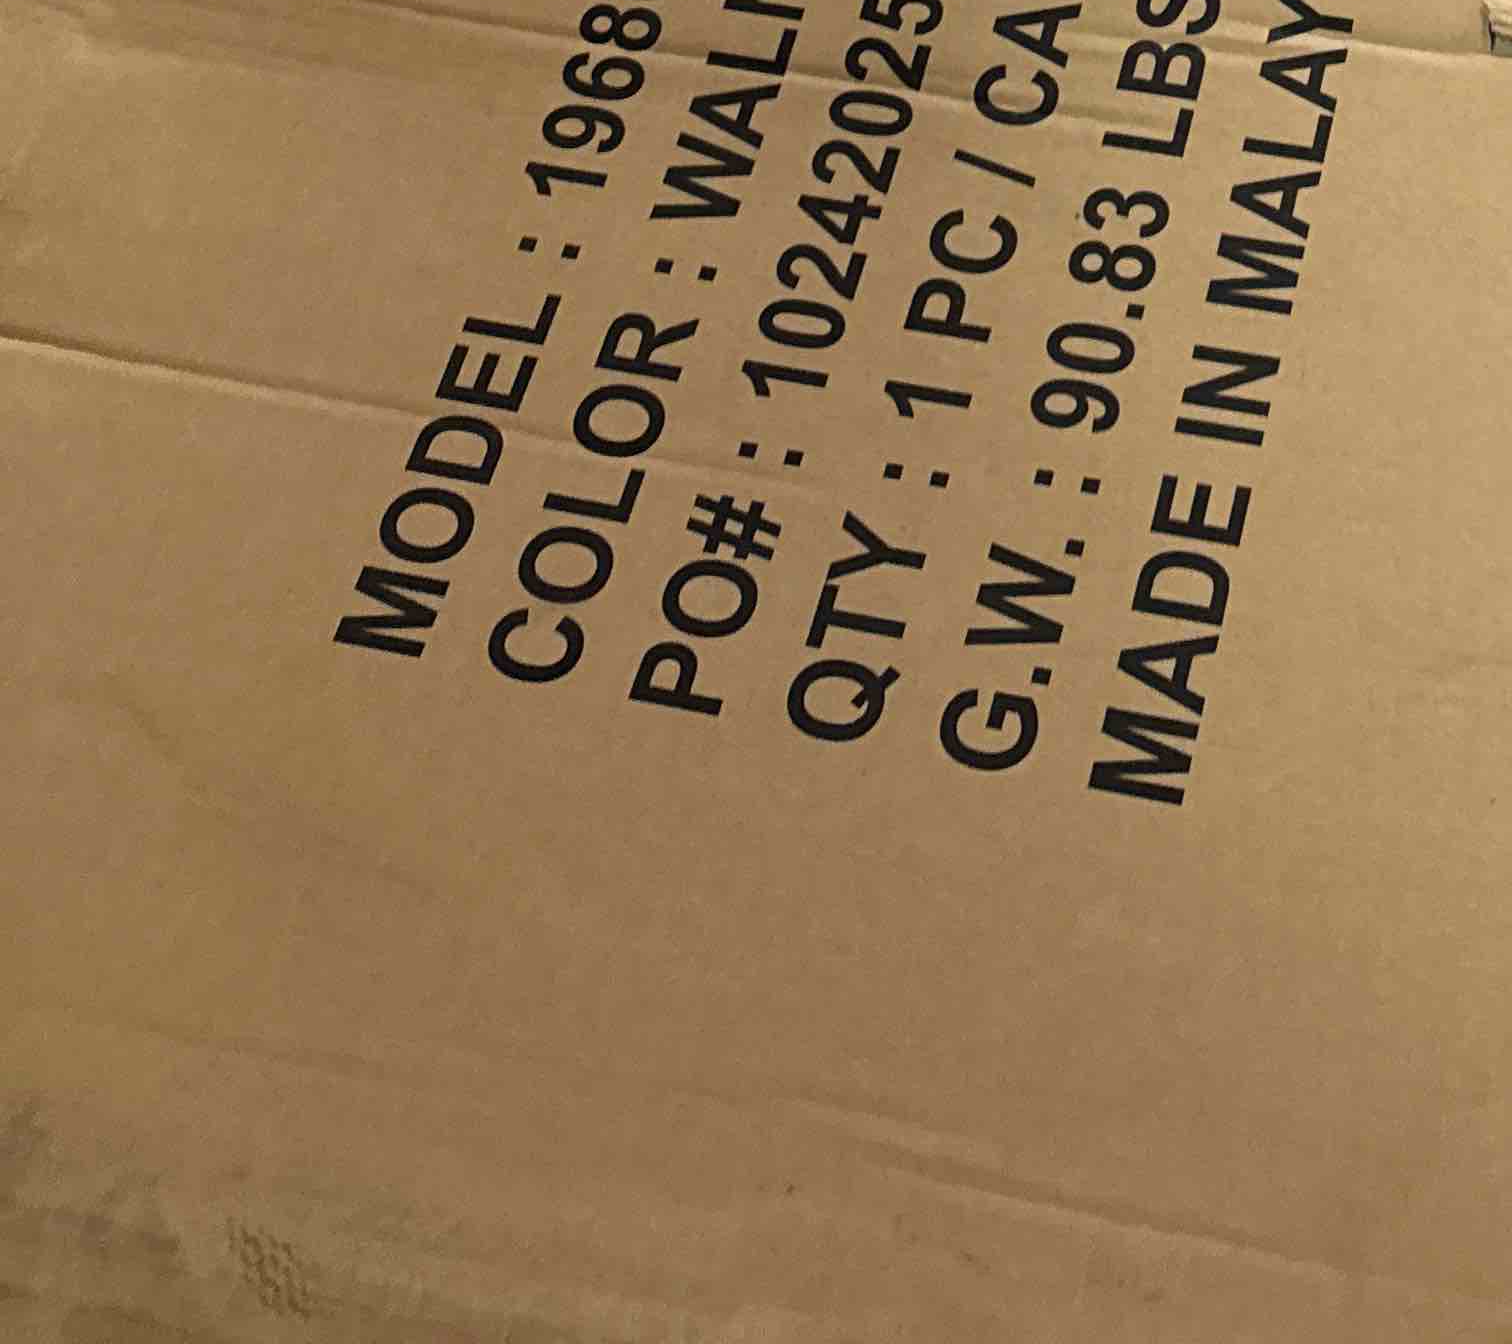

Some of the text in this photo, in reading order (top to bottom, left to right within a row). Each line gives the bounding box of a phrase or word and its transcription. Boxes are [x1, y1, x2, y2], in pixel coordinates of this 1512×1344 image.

[884, 380, 973, 419] 1
[903, 209, 1018, 343] PC
[332, 293, 562, 659] MODEL
[487, 313, 700, 684] COLOR
[628, 493, 782, 717] PO#
[939, 539, 1085, 772] G.W.
[1030, 188, 1170, 433] 90.83
[1087, 474, 1252, 806] MADE
[1174, 345, 1281, 447] IN
[786, 510, 927, 743] QTY
